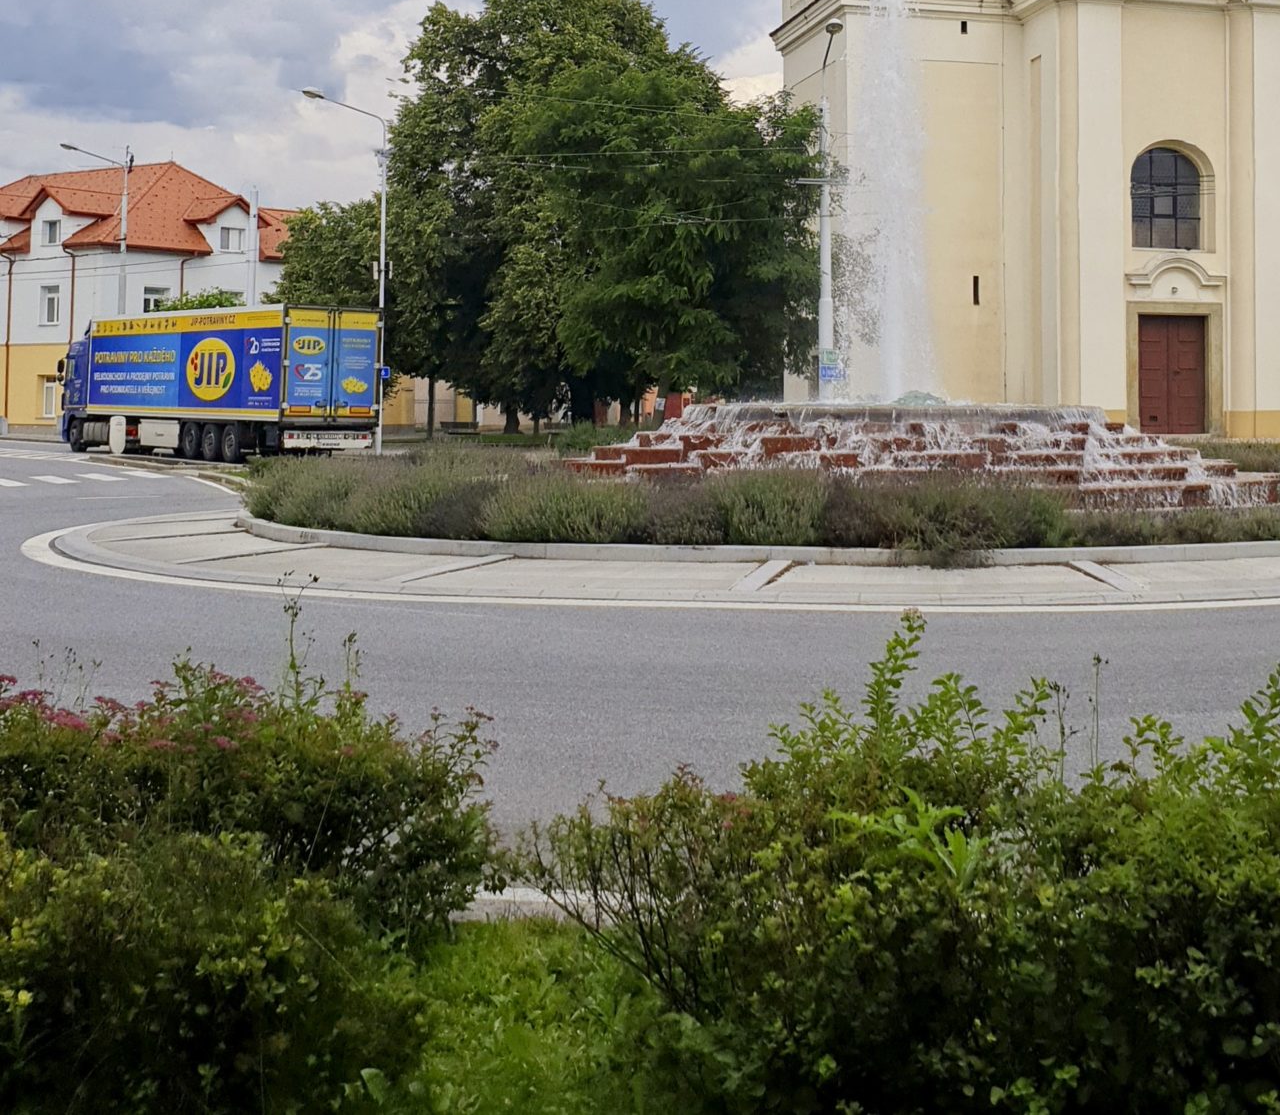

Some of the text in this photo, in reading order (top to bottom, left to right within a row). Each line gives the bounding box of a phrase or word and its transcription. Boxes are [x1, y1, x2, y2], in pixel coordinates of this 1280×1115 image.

[190, 314, 236, 327] JIP-POTRAVINY.CZ
[298, 339, 321, 350] JIP
[95, 346, 176, 364] POTRAVINY PRO KAŽDÉHO
[195, 351, 228, 387] JIP
[303, 363, 322, 381] 25
